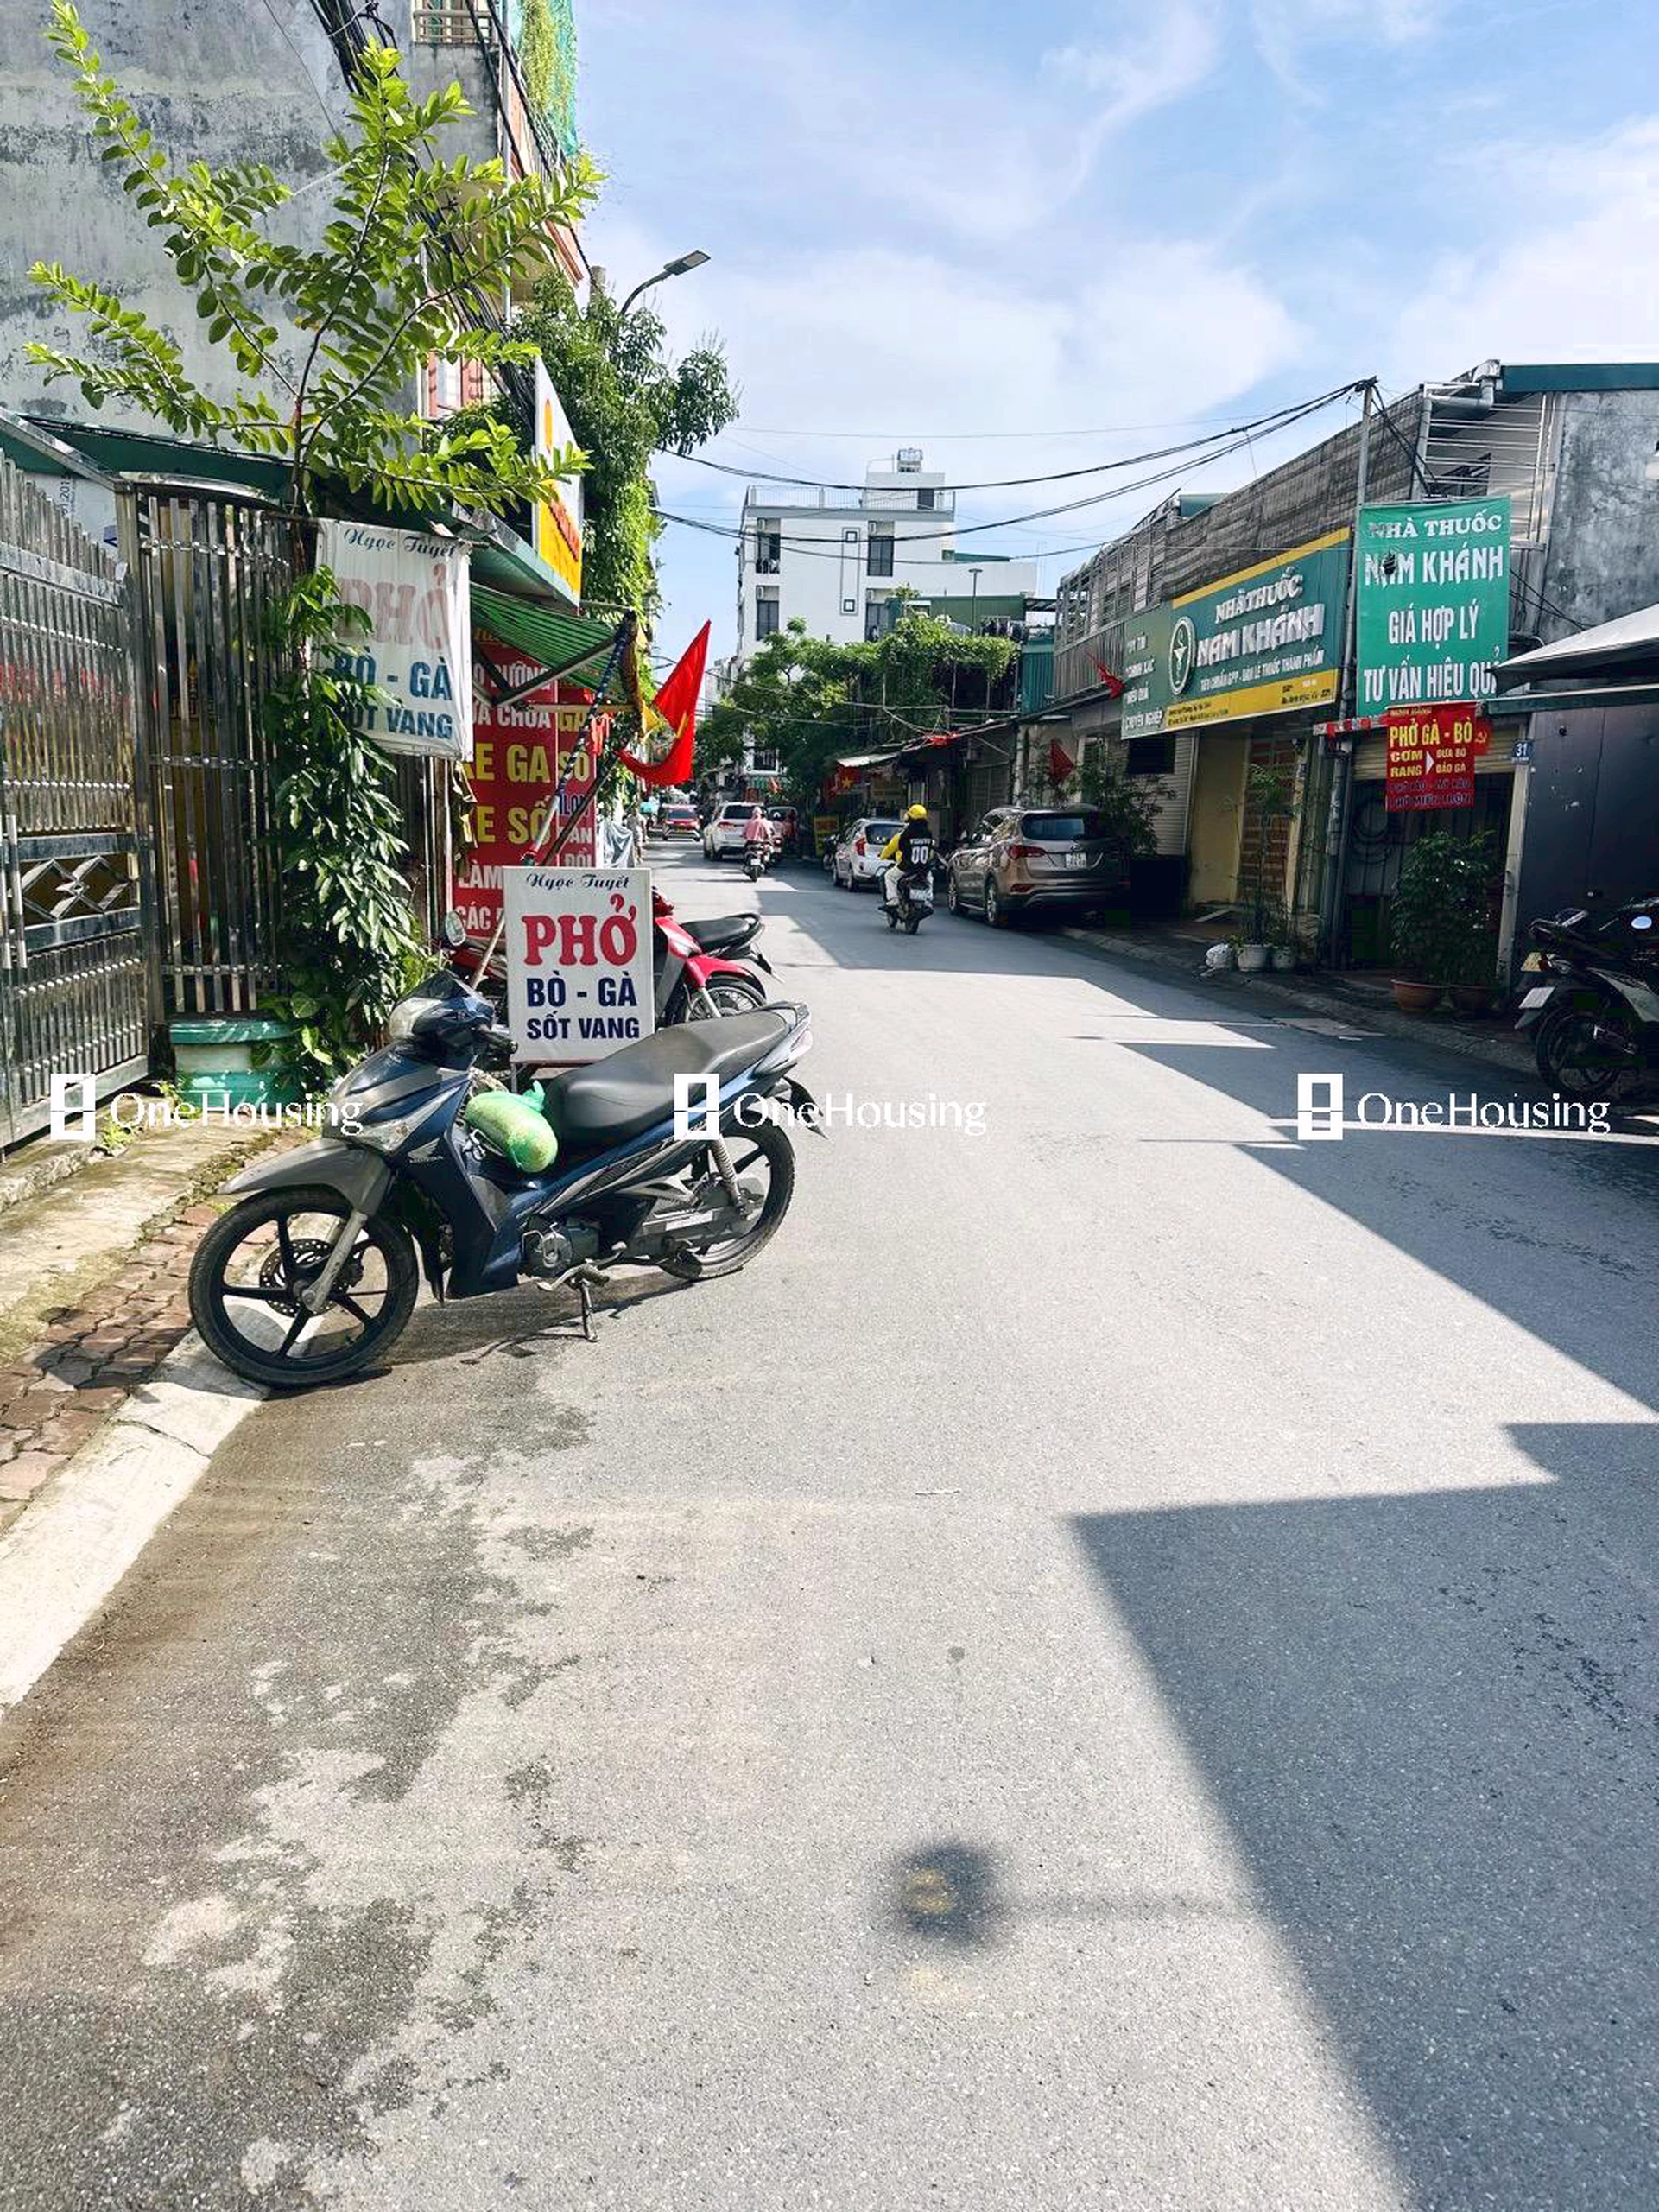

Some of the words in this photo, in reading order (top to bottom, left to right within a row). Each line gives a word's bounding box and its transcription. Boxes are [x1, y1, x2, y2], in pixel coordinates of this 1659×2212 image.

[344, 528, 396, 550] Ngọc
[1368, 517, 1418, 538] NHÀ
[1424, 510, 1502, 537] THUỐC
[1422, 542, 1504, 586] KHÁNH
[1215, 589, 1245, 624] NHÀ
[1244, 567, 1303, 613] THUỐC
[1197, 629, 1241, 667] NAM
[1241, 604, 1325, 655] KHÁNH
[1388, 602, 1416, 645] GIÁ
[1422, 605, 1454, 650] HỢP
[1460, 599, 1479, 640] LÝ
[409, 656, 453, 700] GÀ
[1364, 664, 1388, 702] TƯ
[1389, 654, 1422, 700] VẤN
[1427, 656, 1465, 704] HIỆU
[386, 707, 453, 741] VANG
[1390, 718, 1419, 748] PHỞ
[1453, 716, 1472, 744] BÒ
[507, 744, 551, 783] GA
[1516, 743, 1528, 757] 31
[911, 846, 928, 864] 00
[526, 873, 573, 891] Ngọc
[577, 873, 630, 891] Tuyết
[522, 893, 637, 966] PHỞ
[526, 970, 566, 1007] BÒ
[598, 971, 637, 1007] GÀ
[527, 1011, 571, 1039] SỐT
[579, 1017, 640, 1038] VANG
